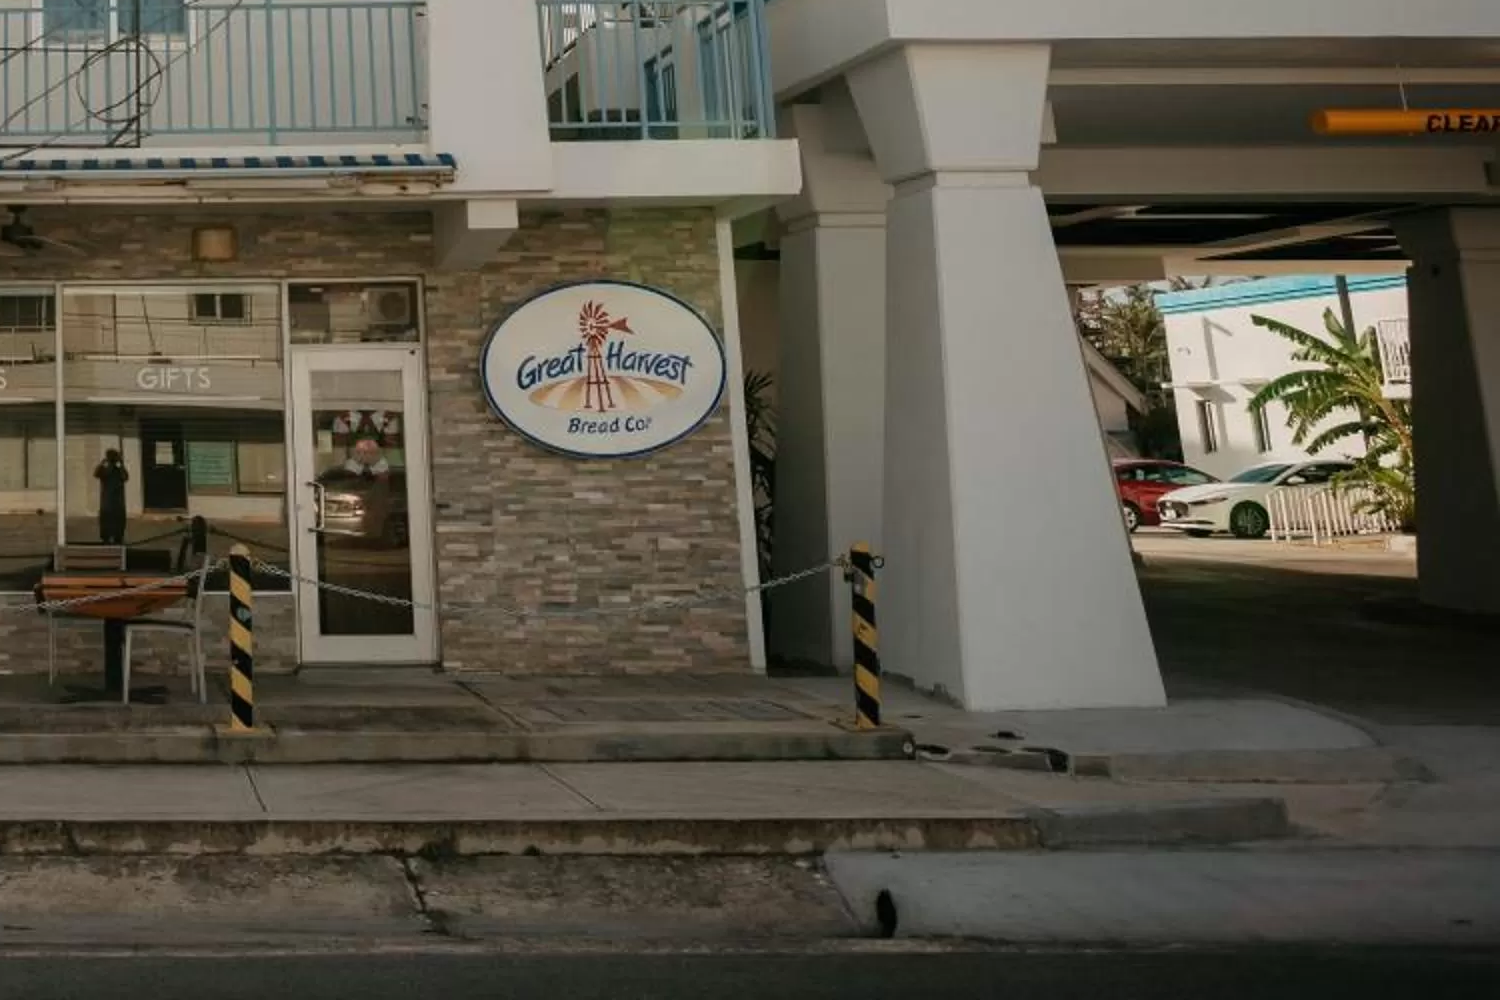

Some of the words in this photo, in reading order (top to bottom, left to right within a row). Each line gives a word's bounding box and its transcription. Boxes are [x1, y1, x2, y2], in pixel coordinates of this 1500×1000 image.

[516, 343, 586, 391] Great
[605, 340, 694, 385] Harvest
[136, 366, 212, 390] GIFTS
[567, 416, 621, 434] Bread
